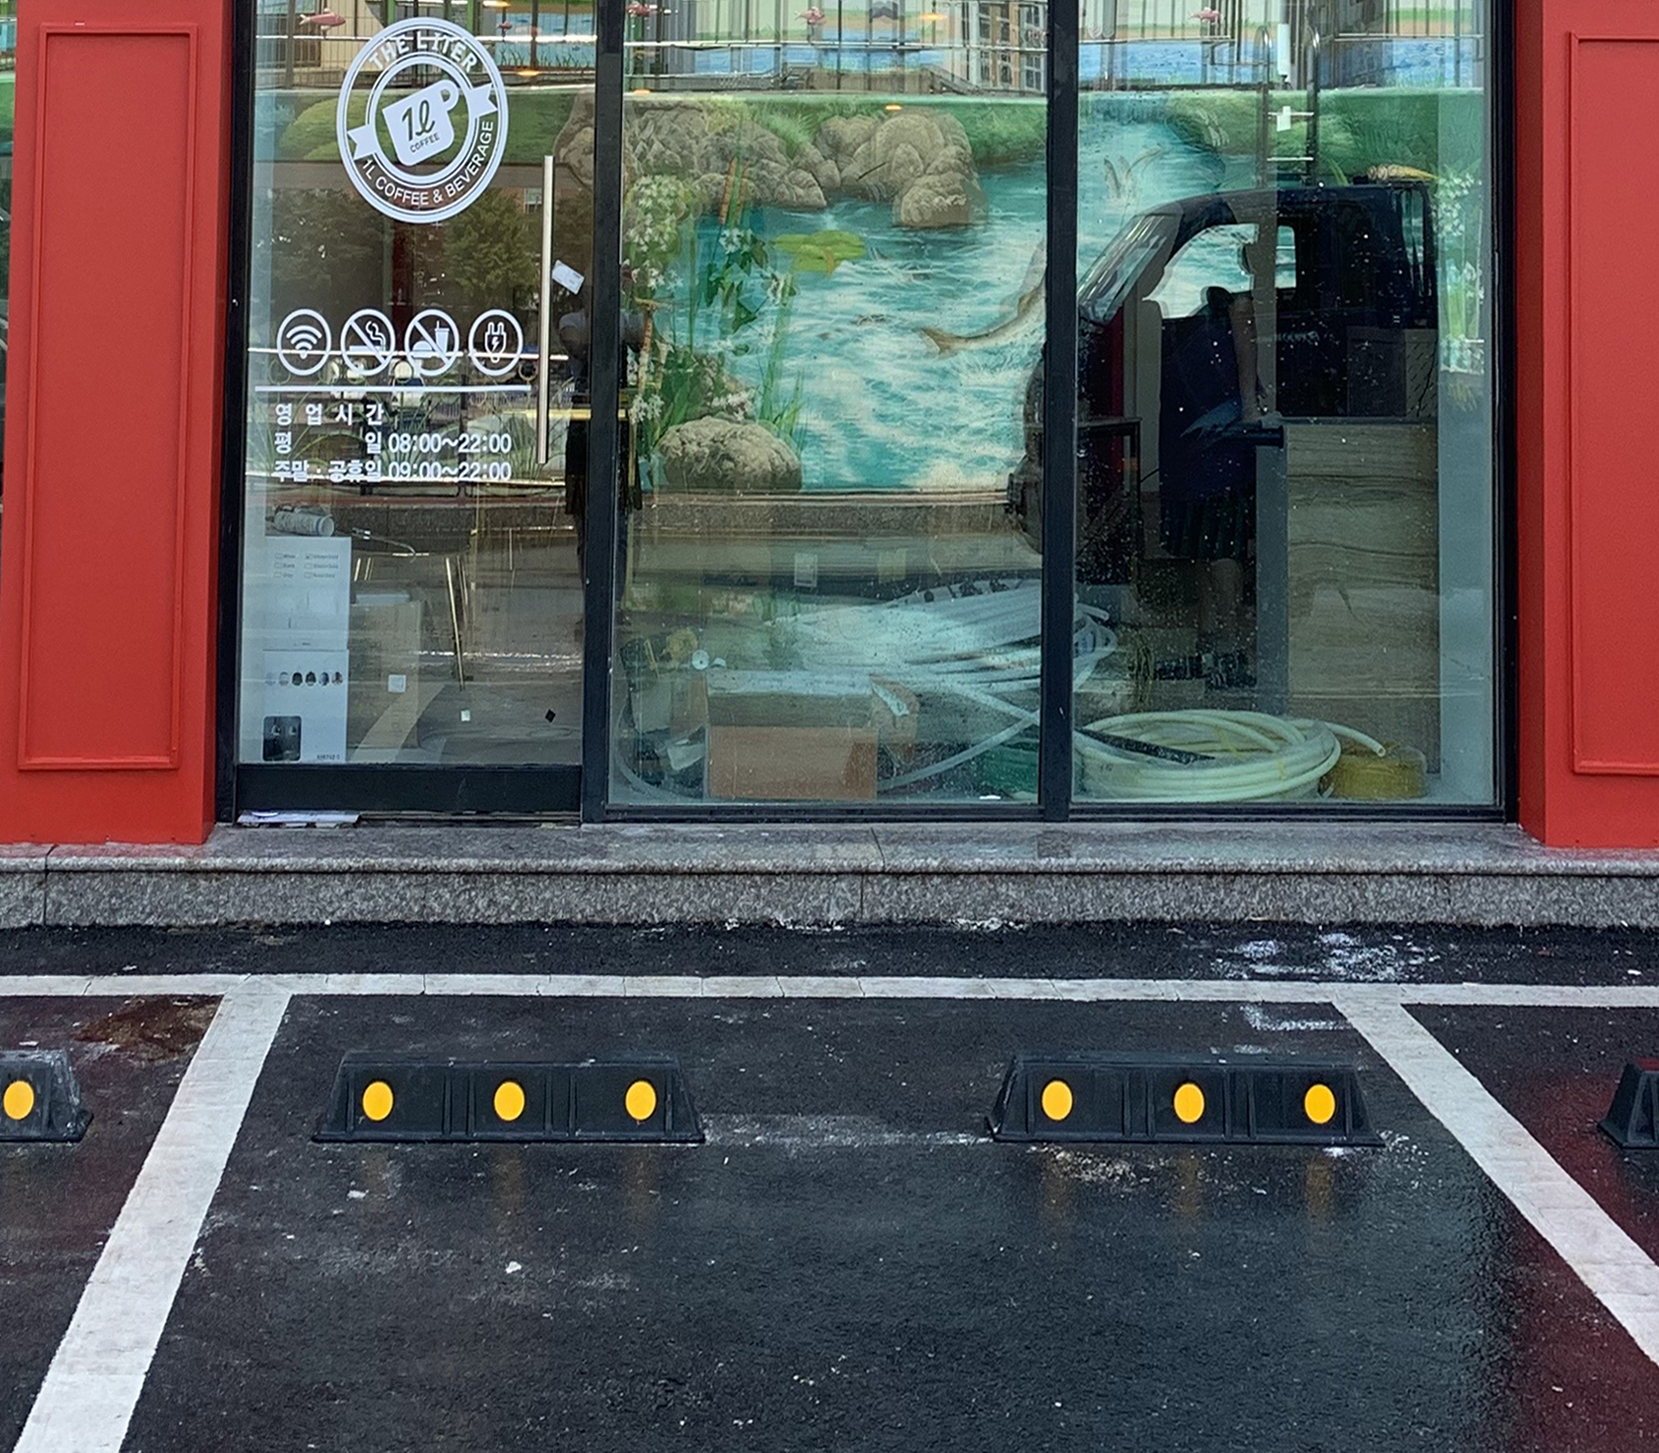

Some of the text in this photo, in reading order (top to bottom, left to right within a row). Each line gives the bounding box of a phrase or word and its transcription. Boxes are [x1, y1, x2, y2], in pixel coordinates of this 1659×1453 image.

[369, 30, 479, 73] THE LITER
[409, 132, 440, 154] COFFEE
[361, 120, 494, 206] 1L COFFEE & BEVERAGE
[388, 433, 512, 454] 08:00~22:00
[388, 460, 512, 481] 09:00~22:00
